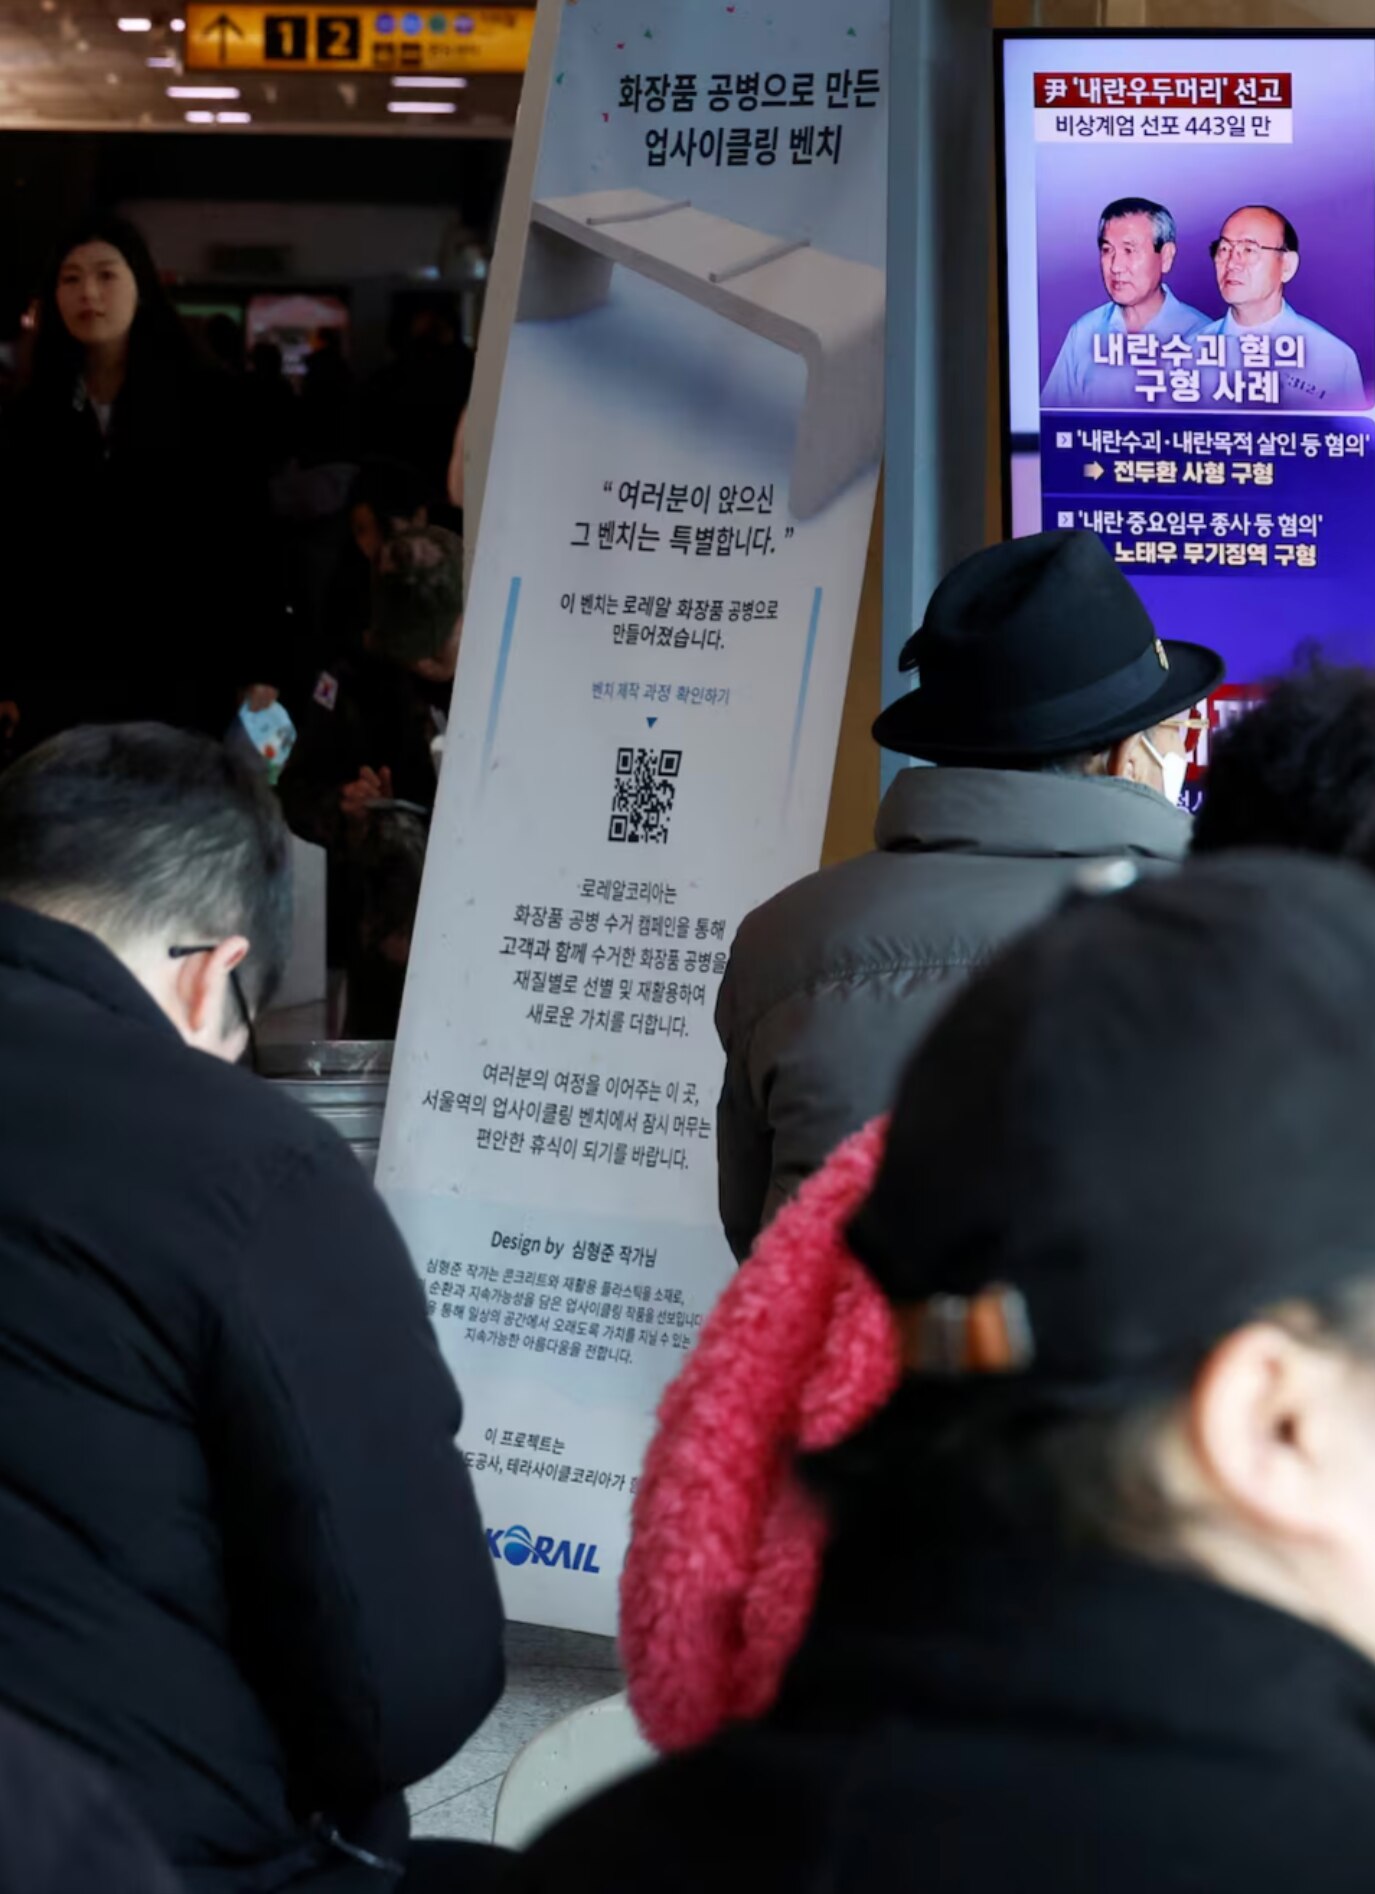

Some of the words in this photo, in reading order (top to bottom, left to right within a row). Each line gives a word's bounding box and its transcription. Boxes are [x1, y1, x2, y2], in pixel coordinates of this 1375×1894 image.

[279, 23, 295, 56] 1
[328, 23, 350, 56] 2
[619, 74, 697, 113] 화장품
[708, 72, 814, 112] 공병으로
[826, 69, 880, 108] 만든
[1044, 78, 1067, 104] 尹
[1073, 77, 1228, 106] '내란우두머리'
[1234, 78, 1282, 105] 선고
[1055, 115, 1134, 137] 비상계엄
[1140, 115, 1180, 137] 선포
[1185, 115, 1246, 137] 443일
[1251, 116, 1271, 137] 만
[645, 127, 779, 166] 업사이클링
[789, 125, 843, 165] 벤치
[1093, 333, 1226, 368] 내란수괴
[1240, 334, 1305, 368] 혐의
[1134, 369, 1199, 403] 구형
[1212, 370, 1279, 404] 사례
[1256, 431, 1297, 457] 살인
[1301, 433, 1321, 457] 등
[1325, 433, 1371, 458] 혐의'
[1114, 461, 1177, 485] 전두환
[1183, 462, 1225, 486] 사형
[1231, 462, 1274, 486] 구형
[718, 483, 774, 515] 앉으신
[570, 521, 591, 547] 그
[598, 520, 660, 552] 벤치는
[1078, 509, 1123, 535] '내란
[1126, 511, 1205, 536] 중요임무
[1209, 512, 1251, 537] 종사
[1254, 514, 1274, 537] 등
[1278, 514, 1323, 539] 혐의'
[1115, 542, 1177, 565] 노태우
[1183, 542, 1268, 566] 무기징역
[1274, 543, 1317, 567] 구형
[561, 593, 575, 615] 이
[581, 594, 618, 615] 벤치는
[622, 595, 672, 618] 로레알
[676, 598, 724, 622] 화장품
[728, 599, 778, 622] 공병으로
[613, 623, 725, 650] 만들어졌습니다.
[592, 681, 614, 700] 벤치
[617, 682, 640, 700] 제작
[643, 683, 671, 702] 과정
[676, 685, 730, 706] 확인하기
[580, 878, 677, 905] 로레알코리아는
[514, 904, 564, 929] 화장품
[569, 908, 600, 932] 공병
[604, 913, 633, 935] 수거
[638, 914, 690, 939] 캠페인을
[694, 918, 726, 941] 통해
[499, 936, 550, 961] 고객과
[556, 940, 588, 964] 함께
[591, 944, 636, 968] 수거한
[640, 948, 680, 971] 화장품
[684, 949, 727, 975] 공병을
[512, 969, 578, 995] 재질별로
[583, 976, 613, 998] 선별
[619, 979, 633, 1000] 및
[637, 980, 706, 1006] 재활용하여
[526, 1003, 574, 1028] 새로운
[579, 1008, 625, 1033] 가치를
[629, 1014, 689, 1038] 더합니다.
[483, 1063, 549, 1090] 여러분의
[554, 1071, 600, 1097] 여정을
[606, 1076, 662, 1103] 이어주는
[665, 1081, 678, 1103] 이
[422, 1088, 486, 1116] 서울역의
[492, 1097, 573, 1127] 업사이클링
[579, 1107, 637, 1133] 벤치에서
[642, 1113, 669, 1135] 잠시
[673, 1115, 711, 1139] 머무는
[476, 1127, 524, 1153] 편안한
[529, 1134, 578, 1160] 휴식이
[582, 1140, 627, 1166] 되기를
[632, 1144, 689, 1170] 바랍니다.
[490, 1230, 541, 1257] Design
[545, 1236, 564, 1259] by
[572, 1240, 614, 1264] 심형준
[619, 1244, 657, 1268] 작가님
[465, 1263, 500, 1282] 작가는
[502, 1268, 560, 1290] 콘크리트와
[563, 1276, 598, 1295] 재활용
[601, 1281, 651, 1302] 플라스틱을
[566, 1297, 623, 1320] 업사이클링
[464, 1327, 520, 1349] 지속가능한
[523, 1335, 582, 1358] 아름다움을
[485, 1427, 498, 1445] 이
[500, 1430, 566, 1455] 프로젝트는
[464, 1451, 503, 1474] 도공사,
[506, 1457, 626, 1491] 테라사이클코리아가
[485, 1524, 600, 1574] KORAIL
